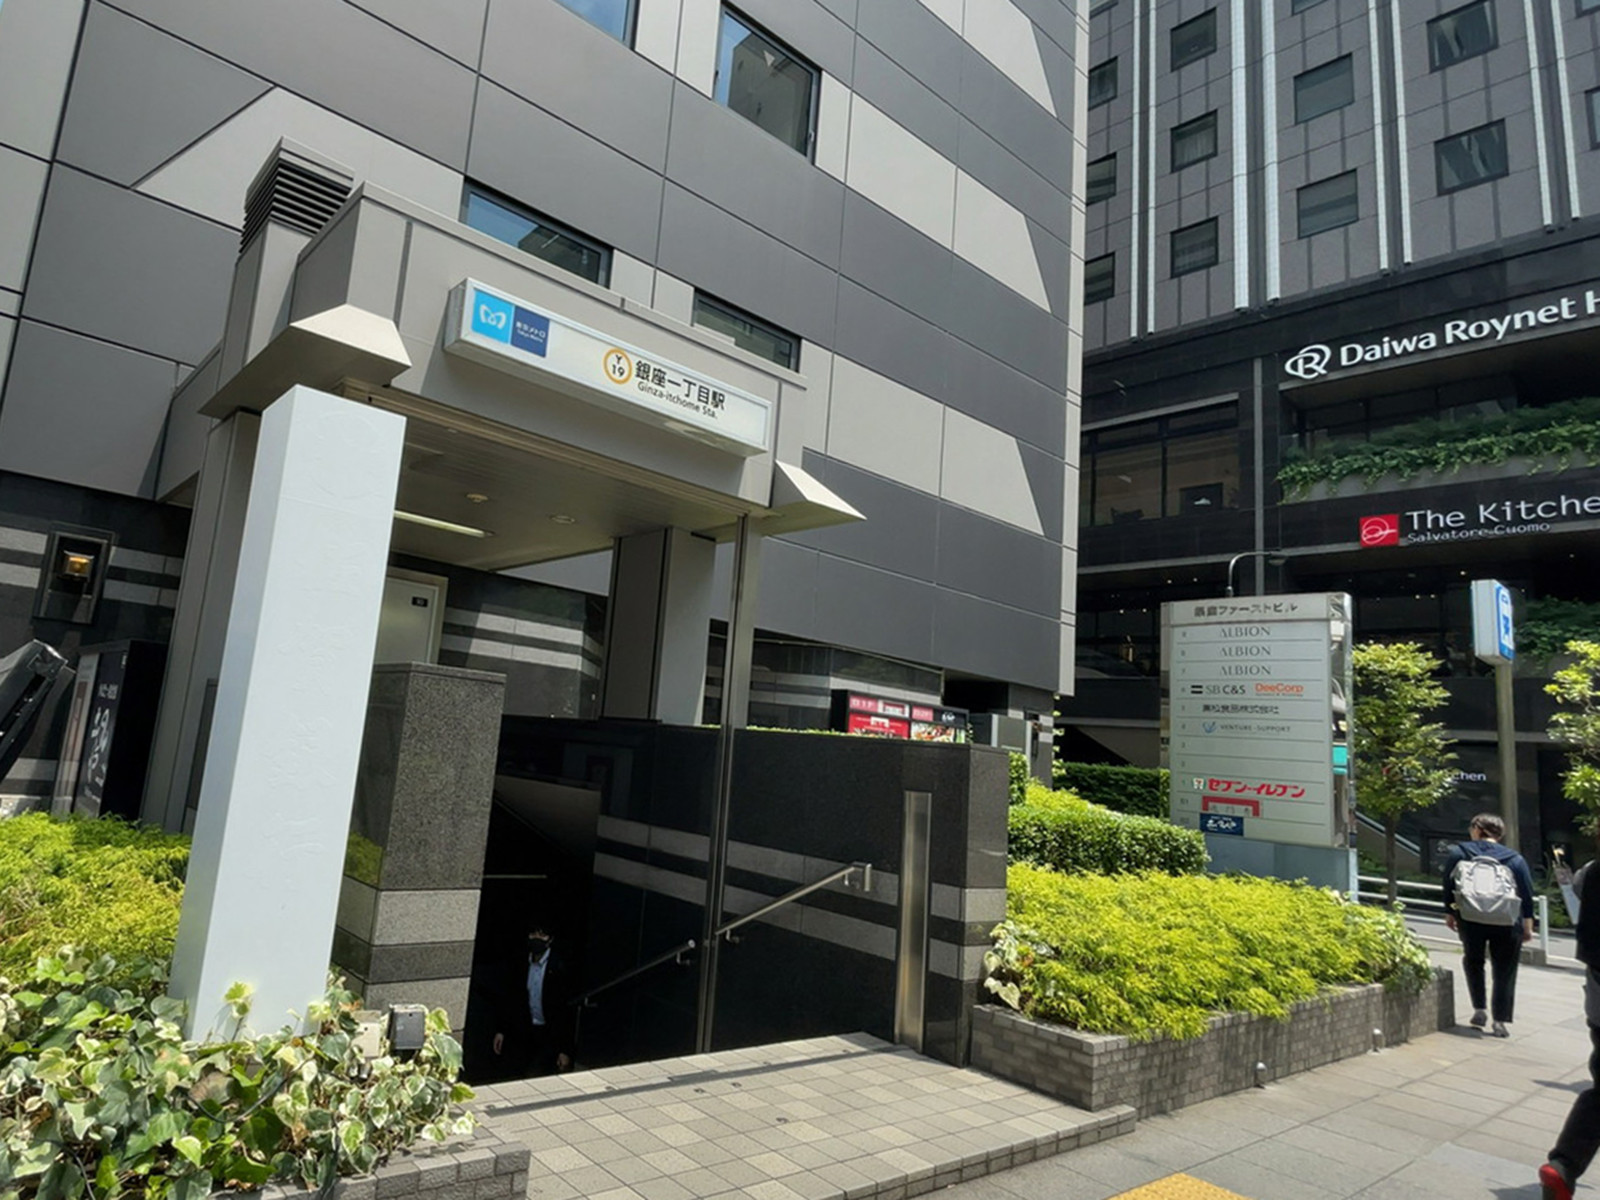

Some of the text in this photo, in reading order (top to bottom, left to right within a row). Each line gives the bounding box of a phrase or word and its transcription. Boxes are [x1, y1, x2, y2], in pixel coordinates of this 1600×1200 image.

[1340, 331, 1437, 367] Daiwa
[1444, 297, 1577, 344] Roynet
[615, 354, 622, 364] Y
[612, 364, 625, 377] 19
[635, 360, 725, 410] 銀座一丁目駅
[637, 381, 718, 419] Ginza-itchome Sta.
[1405, 509, 1465, 530] The
[1407, 521, 1550, 544] Salvatore Cuomo
[1219, 626, 1271, 638] ALBION
[1219, 646, 1271, 657] ALBION
[1219, 665, 1271, 676] ALBION
[1205, 682, 1304, 695] SB C&S DeeCorp
